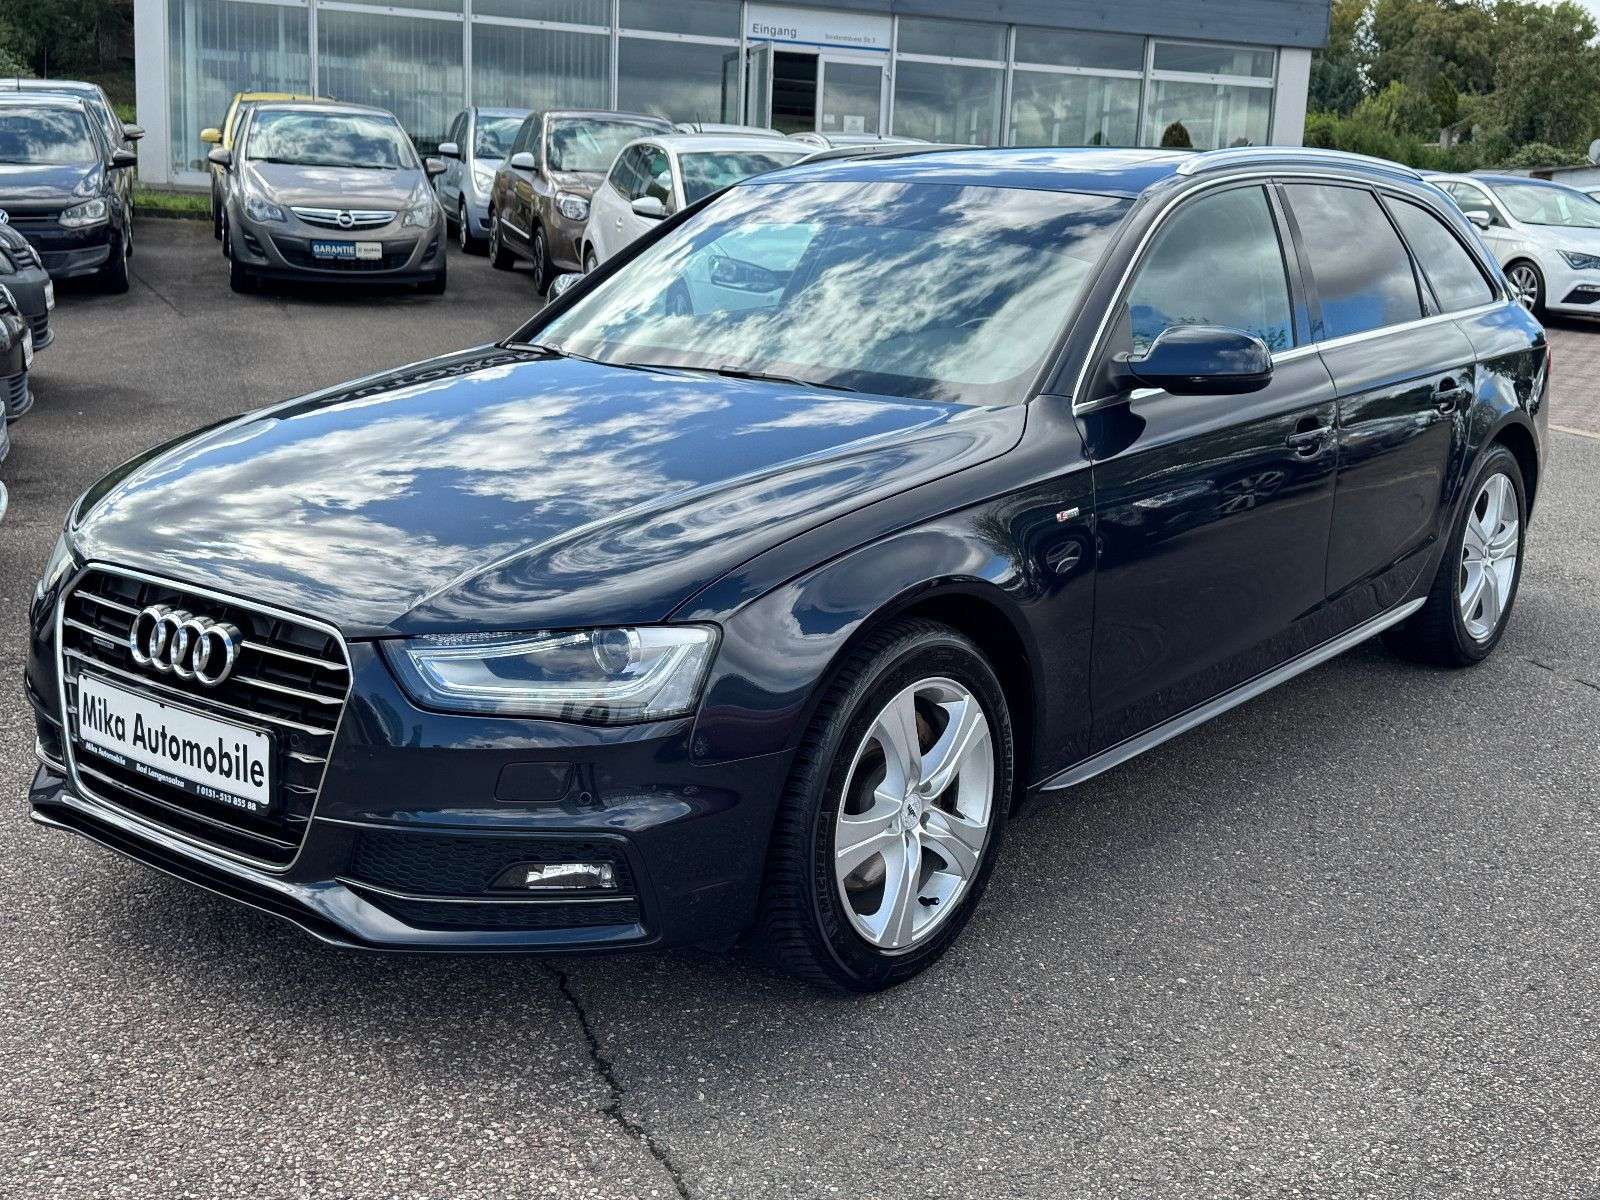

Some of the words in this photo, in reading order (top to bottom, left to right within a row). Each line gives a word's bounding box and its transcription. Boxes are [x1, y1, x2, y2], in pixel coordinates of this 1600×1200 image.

[752, 23, 797, 38] Eingang
[313, 244, 355, 255] GARANTIE
[82, 692, 126, 742] Mika
[132, 712, 265, 787] Automobile
[136, 762, 148, 774] Bad
[233, 796, 246, 808] 855
[247, 801, 257, 811] 88
